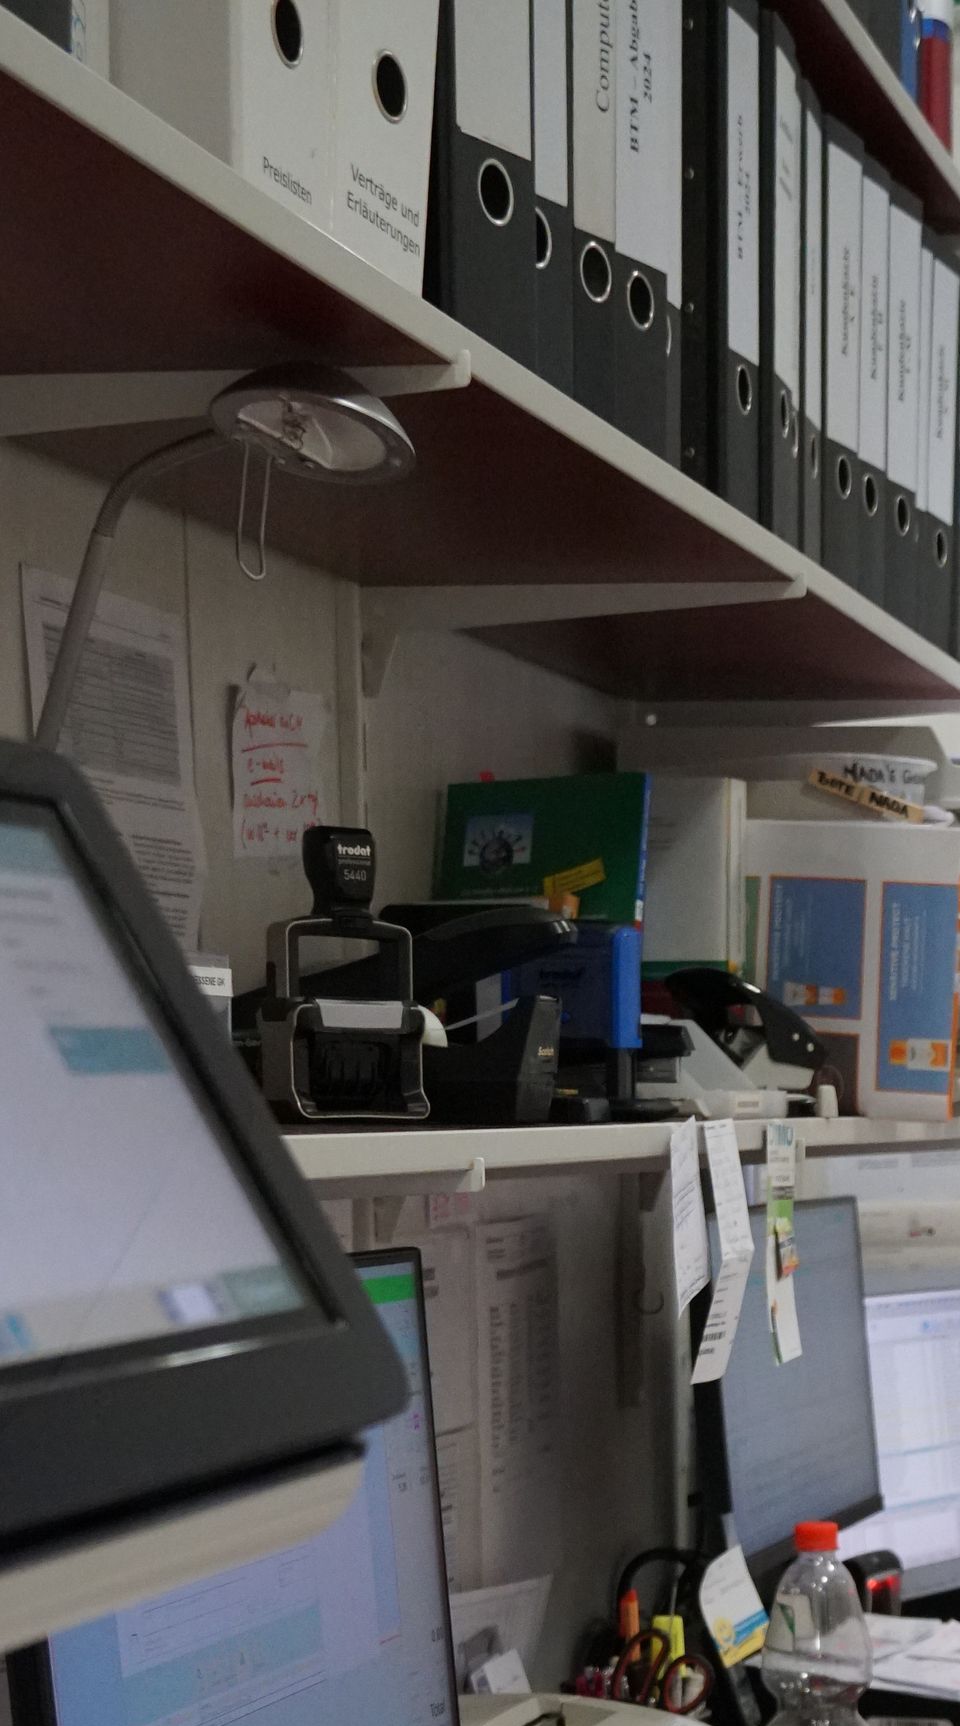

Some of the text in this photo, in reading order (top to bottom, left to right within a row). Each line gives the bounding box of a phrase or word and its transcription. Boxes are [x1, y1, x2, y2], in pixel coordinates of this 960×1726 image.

[643, 51, 653, 103] 2024
[628, 96, 640, 153] BTM
[261, 156, 314, 207] Preislisten
[350, 163, 421, 229] Verträge und
[345, 191, 421, 258] Erläuterungen
[337, 843, 371, 858] trodat
[343, 868, 368, 882] 5440
